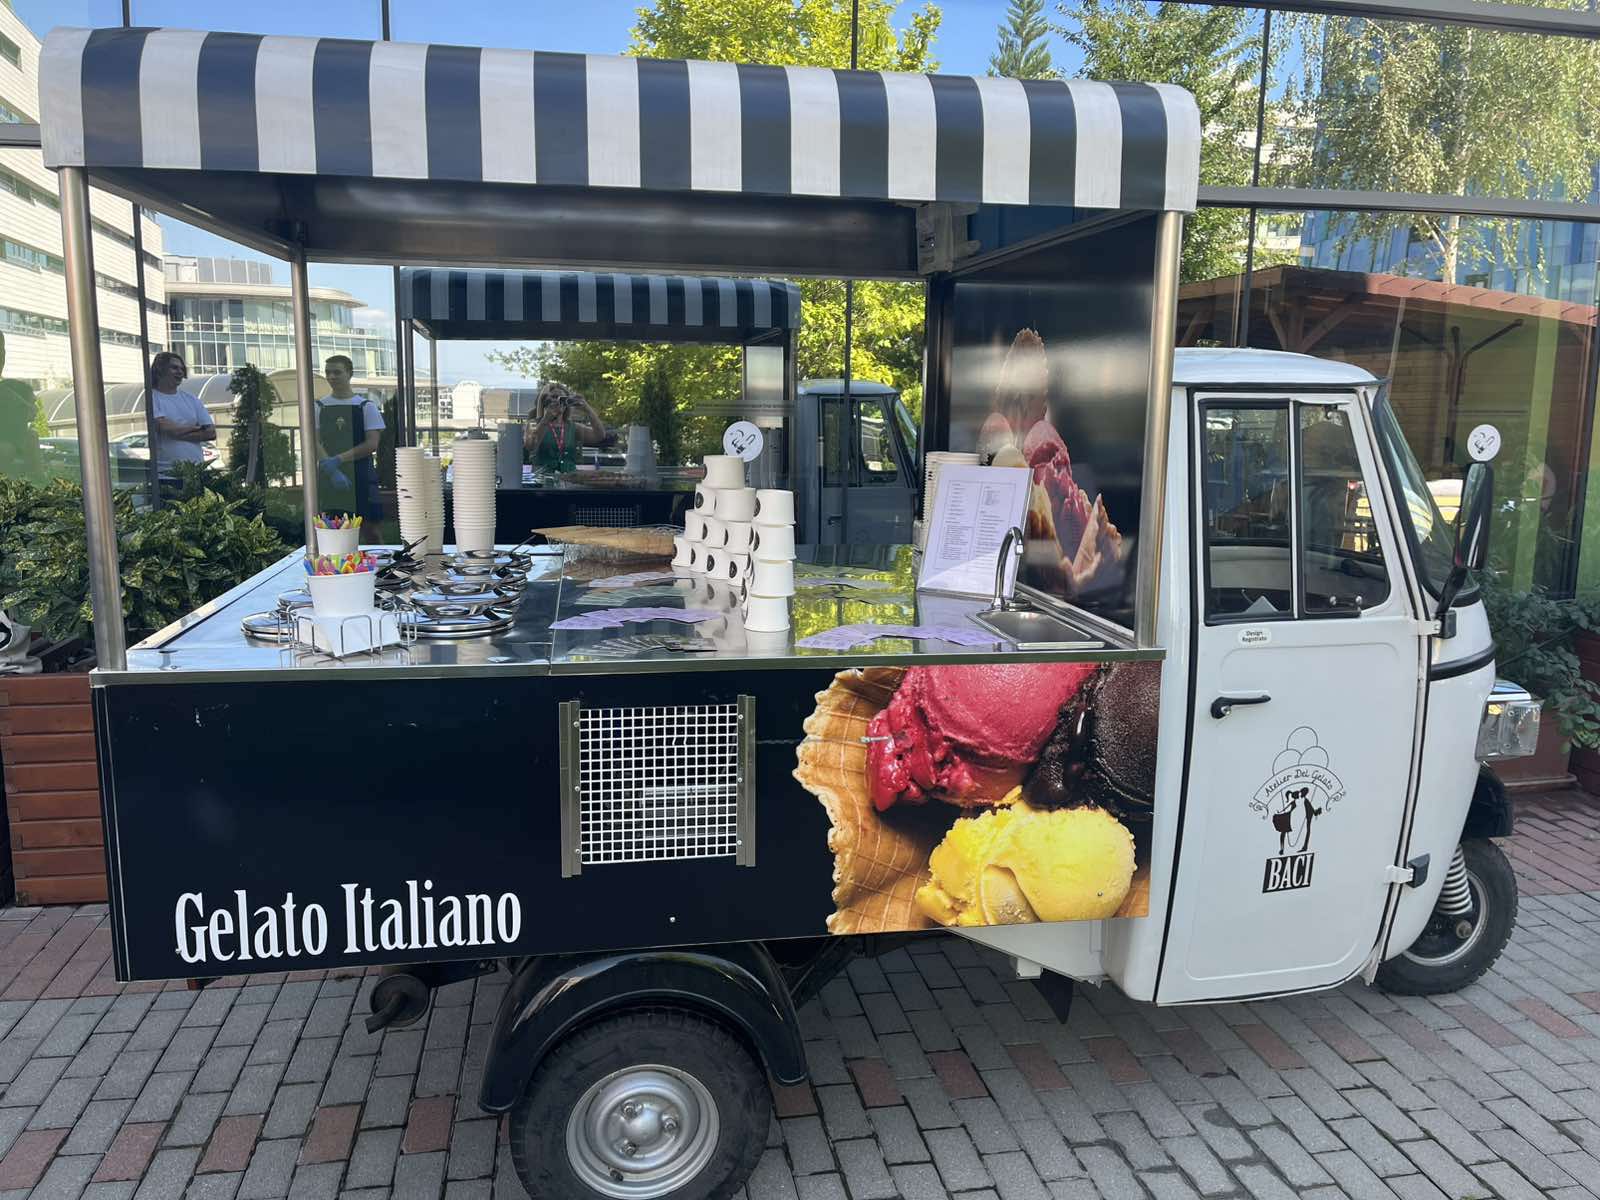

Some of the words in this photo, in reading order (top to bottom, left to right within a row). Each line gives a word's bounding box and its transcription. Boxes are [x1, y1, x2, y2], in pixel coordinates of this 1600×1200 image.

[1264, 775, 1292, 797] Atelier
[1311, 769, 1333, 790] Gelato
[1266, 854, 1313, 891] BACI
[175, 889, 328, 963] Gelato
[341, 879, 522, 954] Italiano
